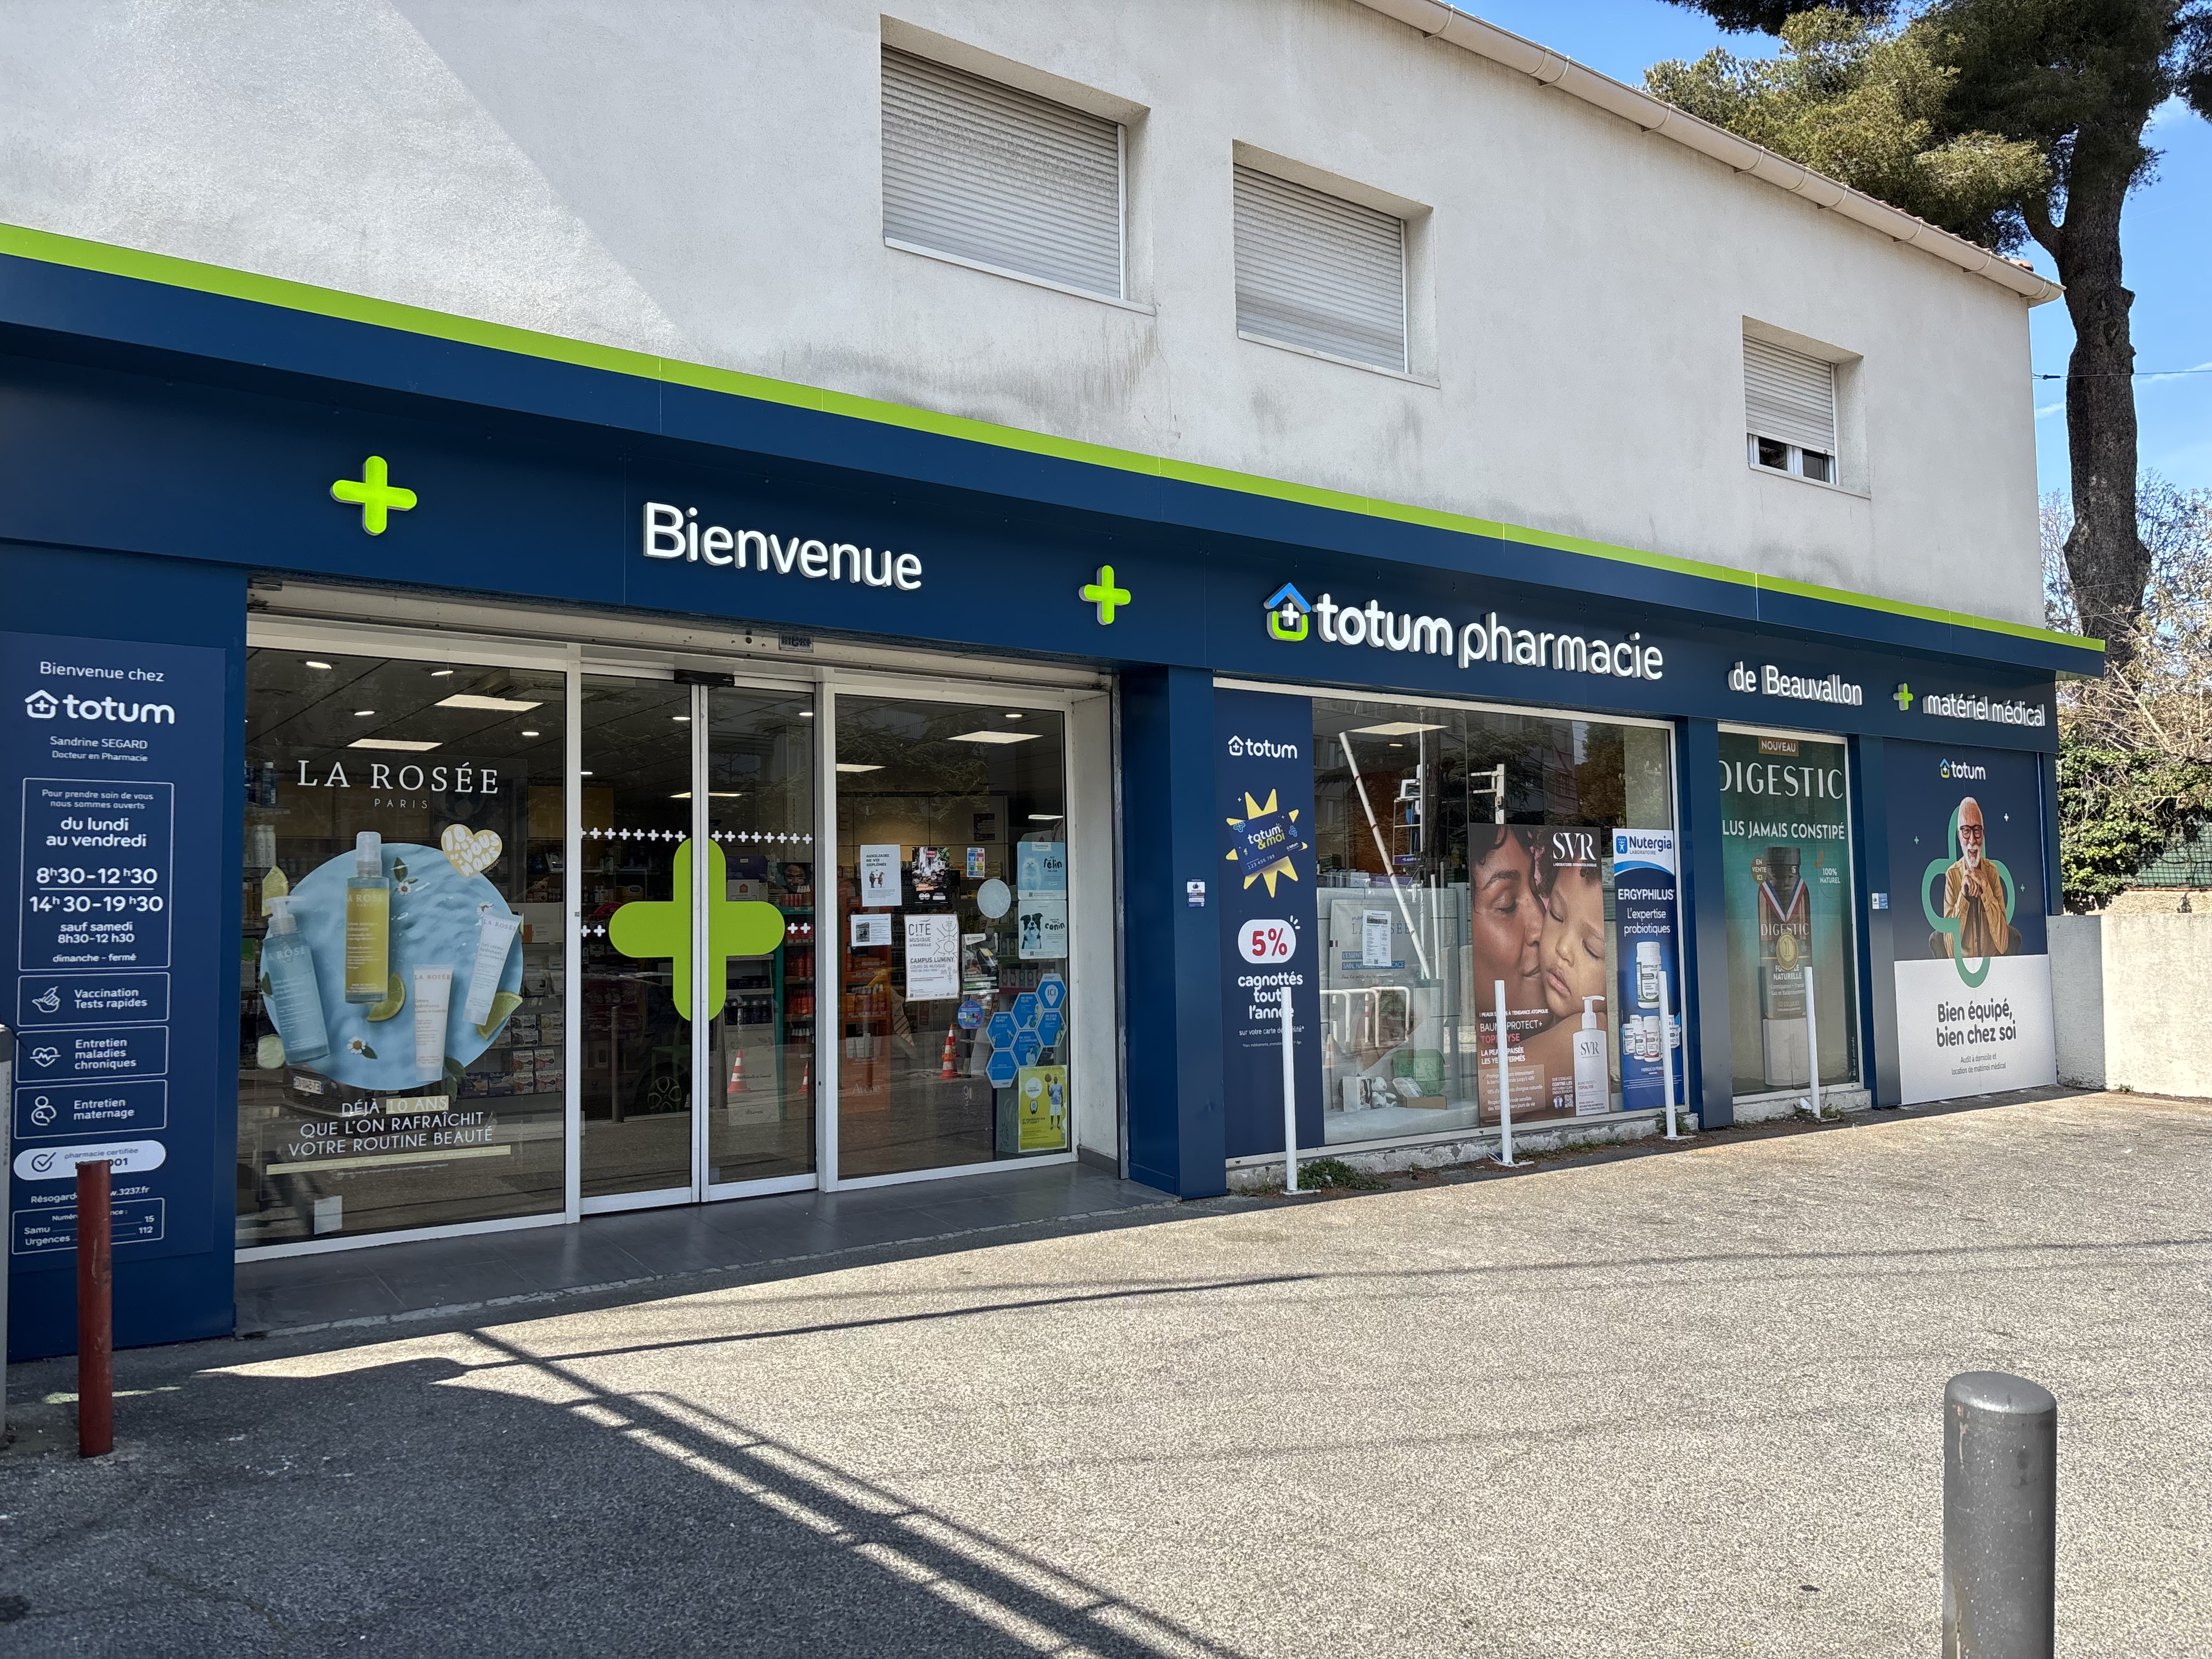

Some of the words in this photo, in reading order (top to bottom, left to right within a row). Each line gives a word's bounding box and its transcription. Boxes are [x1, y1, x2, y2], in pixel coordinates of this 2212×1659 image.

[643, 501, 923, 591] Bienvenue
[1312, 593, 1452, 656] totum
[1458, 611, 1663, 680] pharmacie
[40, 661, 124, 680] Bienvenue
[128, 667, 165, 682] chez
[1728, 661, 1757, 692] de
[1760, 664, 1863, 706] Beauvallon
[63, 694, 176, 724] totum
[1922, 692, 1988, 721] matériel
[1991, 699, 2046, 727] médical
[50, 736, 99, 748] Sandrine
[101, 738, 148, 749] SEGARD
[1245, 738, 1298, 759] totum
[1761, 740, 1797, 753] NOUVEAU
[52, 751, 86, 760] Docteur
[101, 752, 148, 762] Pharmacie
[297, 760, 351, 788] LA
[370, 761, 498, 794] ROSÉE
[1951, 761, 1987, 780] totum
[42, 788, 62, 798] Pour
[64, 790, 99, 800] prendre
[100, 791, 120, 799] soin
[121, 791, 132, 799] de
[113, 801, 145, 810] ouverts
[374, 798, 428, 809] PARIS
[60, 816, 83, 831] du
[88, 817, 129, 831] lundi
[1748, 821, 1788, 839] JAMAIS
[46, 836, 67, 847] au
[72, 833, 147, 848] vendredi
[1247, 826, 1280, 844] totum
[1553, 832, 1597, 860] SVR
[1629, 836, 1672, 852] Nutergia
[1043, 857, 1063, 869] félin
[1822, 867, 1837, 877] 100%
[1627, 907, 1667, 921] L'expertise
[60, 921, 88, 932] sauf
[89, 921, 133, 932] samedi
[1045, 922, 1065, 932] canin
[1624, 923, 1671, 937] probiotiques
[1761, 923, 1809, 936] DIGESTIC
[1252, 928, 1288, 956] 5%
[52, 953, 100, 963] dimanche
[108, 952, 137, 962] fermé
[1238, 971, 1304, 990] cagnottés
[1773, 972, 1802, 981] NATURELLE
[74, 988, 139, 998] Vaccination
[1254, 988, 1282, 1002] tout
[74, 999, 104, 1009] Tests
[106, 998, 148, 1010] rapides
[1937, 1001, 1965, 1023] Bien
[1968, 997, 2013, 1023] équipé,
[1936, 1026, 1964, 1047] bien
[1967, 1024, 1996, 1045] chez
[1999, 1019, 2017, 1041] soi
[75, 1038, 128, 1049] Entretien
[1581, 1042, 1600, 1056] SVR
[75, 1049, 127, 1059] maladies
[1975, 1053, 1992, 1062] domicile
[74, 1059, 137, 1071] chroniques
[1973, 1063, 1991, 1071] matériel
[1990, 1061, 2006, 1070] médical
[74, 1098, 126, 1110] Entretien
[342, 1098, 380, 1116] DÉJÀ
[387, 1099, 408, 1113] 10
[416, 1096, 448, 1111] ANS
[74, 1108, 135, 1120] maternage
[300, 1121, 338, 1139] QUE
[345, 1118, 384, 1135] L'ON
[391, 1111, 484, 1131] RAFRAÎCHIT
[289, 1138, 346, 1157] VOTRE
[353, 1133, 427, 1152] ROUTINE
[433, 1125, 493, 1146] BEAUTÉ
[64, 1150, 105, 1159] pharmacie
[106, 1147, 139, 1156] certifiée
[24, 1226, 50, 1235] Samu
[25, 1235, 70, 1246] Urgences
